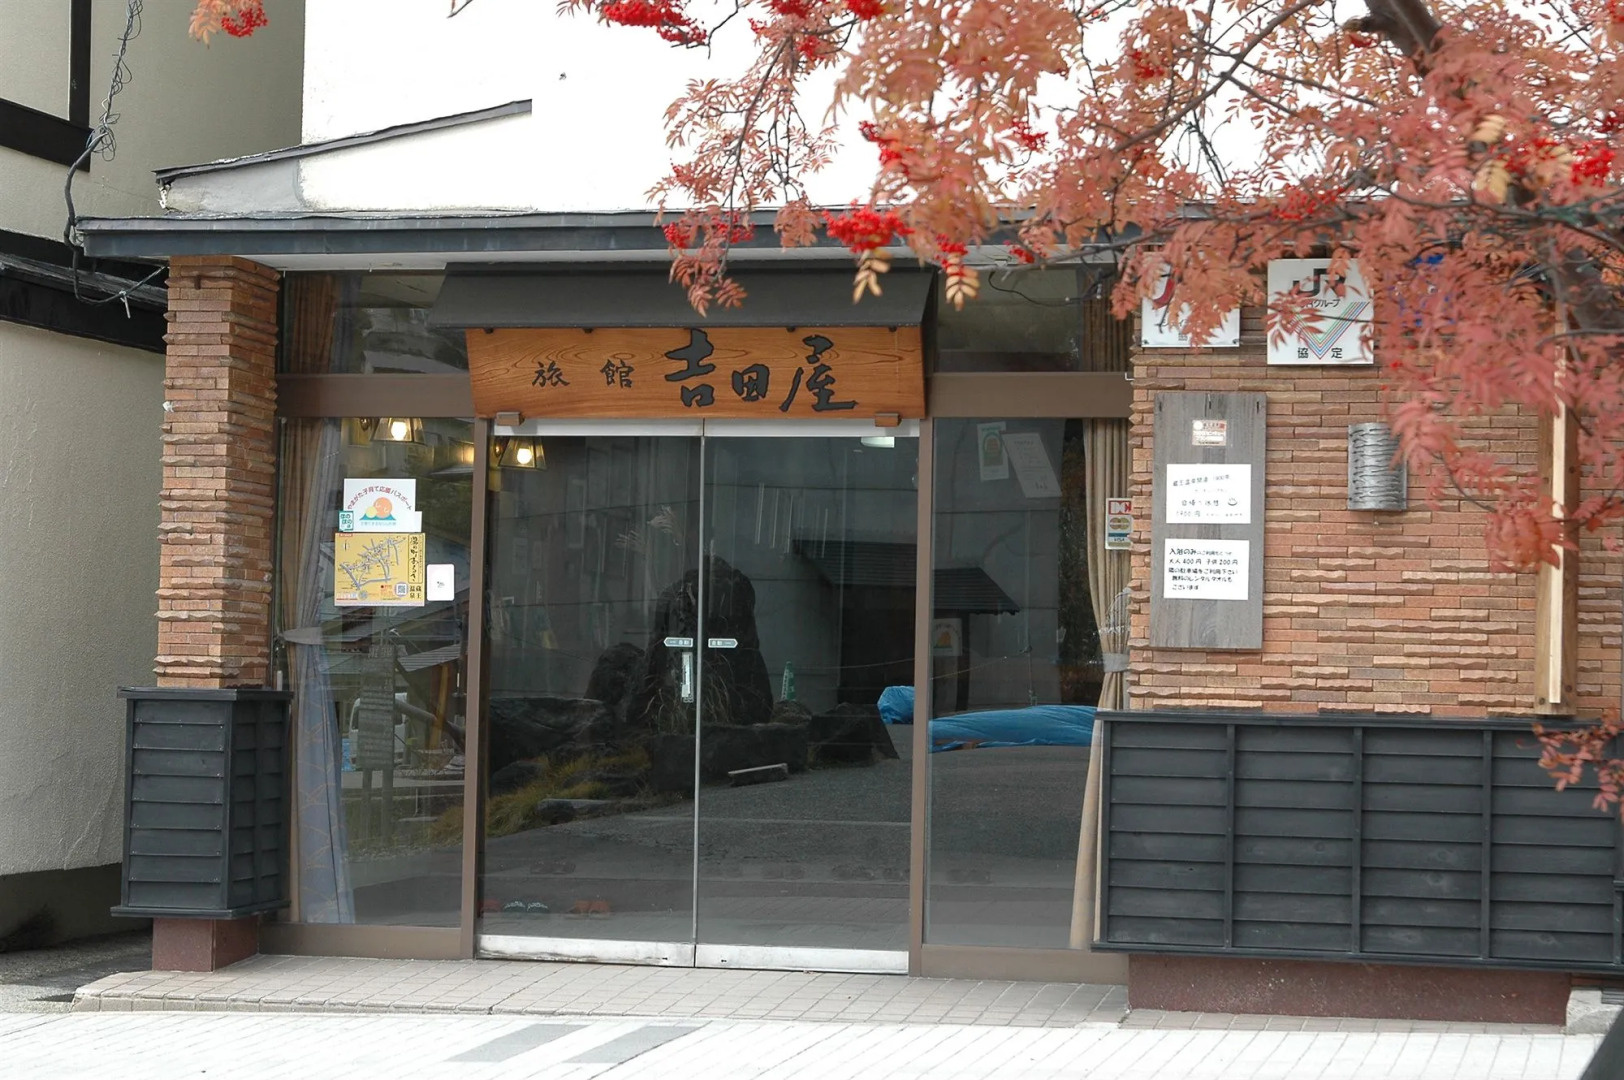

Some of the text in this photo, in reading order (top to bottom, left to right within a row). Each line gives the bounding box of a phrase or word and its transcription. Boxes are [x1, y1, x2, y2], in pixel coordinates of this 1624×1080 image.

[532, 328, 859, 412] 旅館 吉田屋
